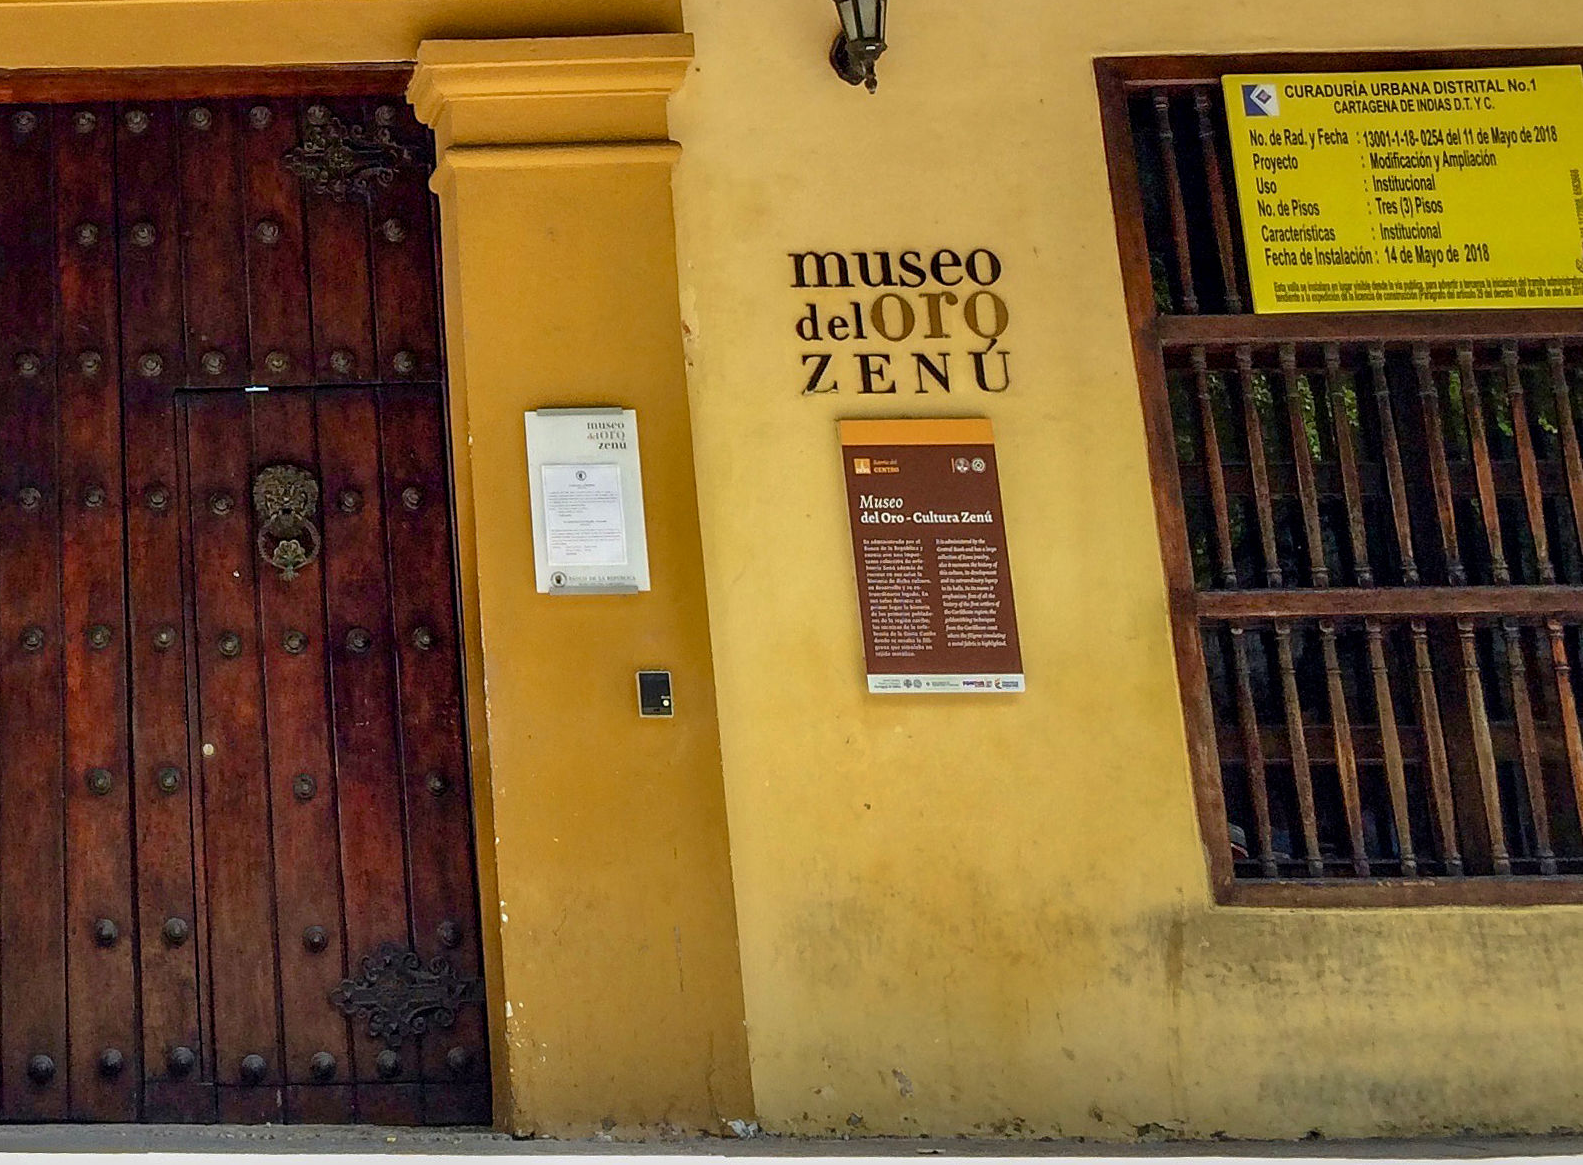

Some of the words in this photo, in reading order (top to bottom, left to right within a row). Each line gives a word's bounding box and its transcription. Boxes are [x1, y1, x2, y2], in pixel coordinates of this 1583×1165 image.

[1284, 80, 1368, 98] CURADURÍA
[1370, 81, 1431, 96] URBANA
[1433, 79, 1505, 94] DISTRITAL
[1507, 78, 1537, 92] No.1
[1333, 99, 1399, 113] CARTAGENA
[1400, 99, 1415, 112] DE
[1416, 97, 1452, 111] INDIAS
[1454, 97, 1473, 110] D.T.
[1474, 96, 1482, 109] Y
[1484, 96, 1496, 109] C.
[1249, 130, 1268, 147] No.
[1269, 129, 1282, 146] de
[1283, 128, 1307, 146] Rad.
[1309, 132, 1316, 150] y
[1317, 128, 1349, 145] Fecha
[1420, 128, 1444, 146] 0254
[1446, 127, 1462, 145] del
[1463, 127, 1474, 145] 11
[1476, 127, 1490, 144] de
[1490, 126, 1518, 148] Mayo
[1520, 125, 1533, 143] de
[1533, 125, 1558, 142] 2018
[1252, 153, 1298, 174] Proyecto
[1369, 151, 1433, 169] Modificación
[1434, 154, 1440, 172] y
[1442, 149, 1498, 171] Ampliación
[1256, 177, 1278, 194] Uso
[1372, 173, 1436, 192] Institucional
[1257, 199, 1275, 217] No.
[1277, 199, 1290, 216] de
[1291, 199, 1320, 216] Pisos
[1375, 197, 1398, 215] Tres
[1399, 196, 1414, 218] (3)
[1414, 196, 1443, 213] Pisos
[1379, 221, 1443, 240] Institucional
[1264, 247, 1298, 266] Fecha
[1299, 246, 1313, 265] de
[1315, 245, 1373, 265] Instalación
[1384, 245, 1398, 263] 14
[1399, 245, 1413, 263] de
[1414, 244, 1444, 268] Mayo
[1446, 244, 1459, 262] de
[1464, 243, 1490, 262] 2018
[787, 248, 1002, 288] museo
[795, 301, 868, 341] del
[870, 290, 1010, 342] oro
[801, 338, 1011, 395] ZENÚ
[859, 495, 904, 509] Museo
[860, 511, 879, 524] del
[881, 512, 905, 524] Oro
[913, 510, 960, 524] Cultura
[960, 510, 994, 523] Zenú
